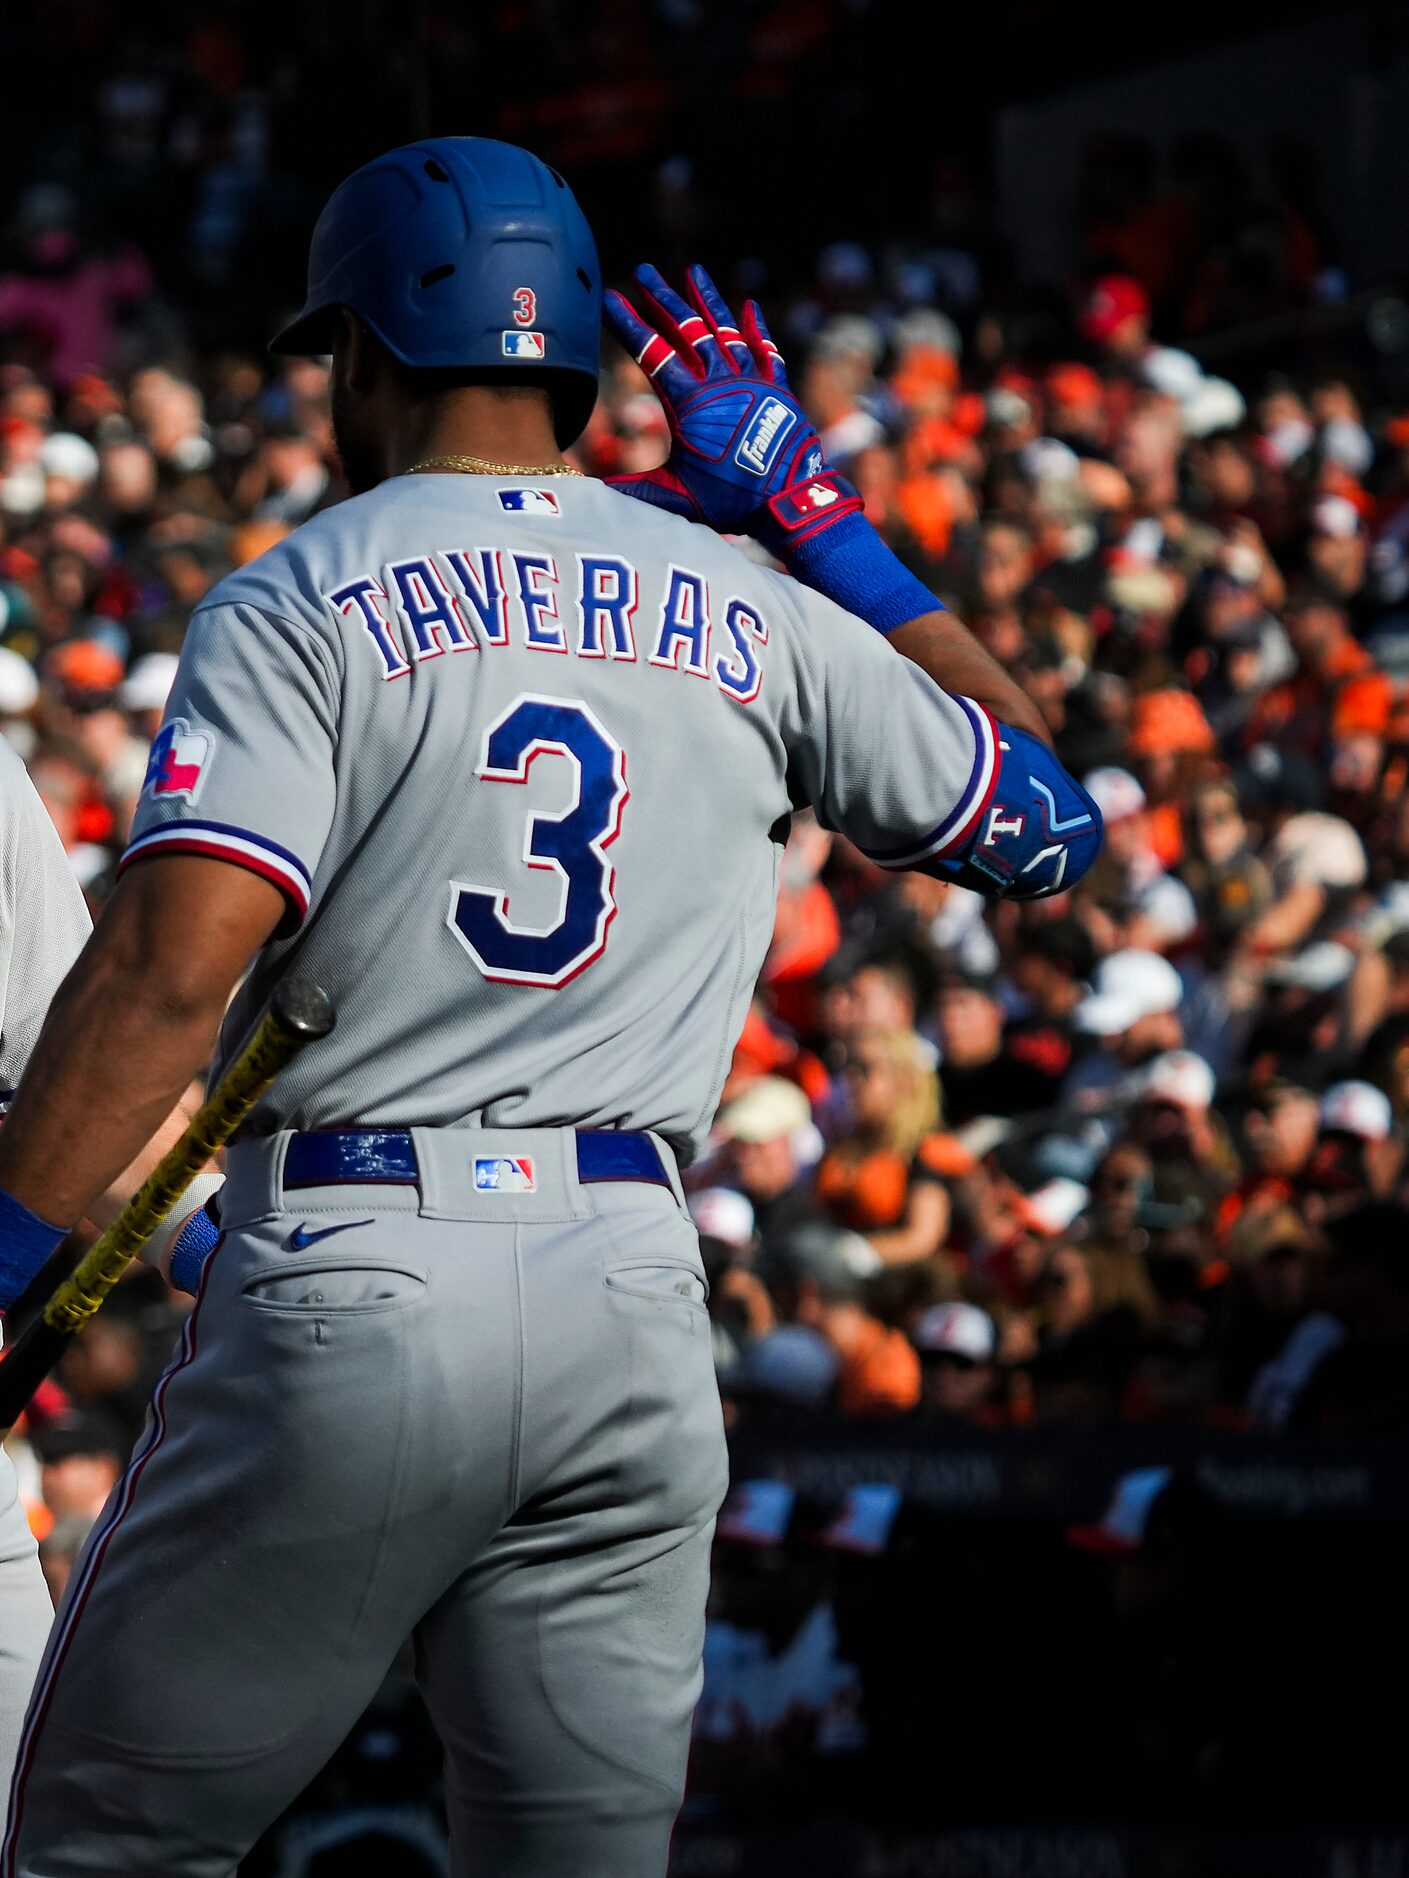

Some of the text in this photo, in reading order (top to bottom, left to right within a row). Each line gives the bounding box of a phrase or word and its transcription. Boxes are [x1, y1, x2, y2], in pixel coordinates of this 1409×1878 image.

[512, 287, 536, 326] 3
[742, 401, 788, 472] Franklin
[325, 546, 769, 703] TAVERAS
[446, 692, 630, 990] 3
[983, 804, 1026, 846] T
